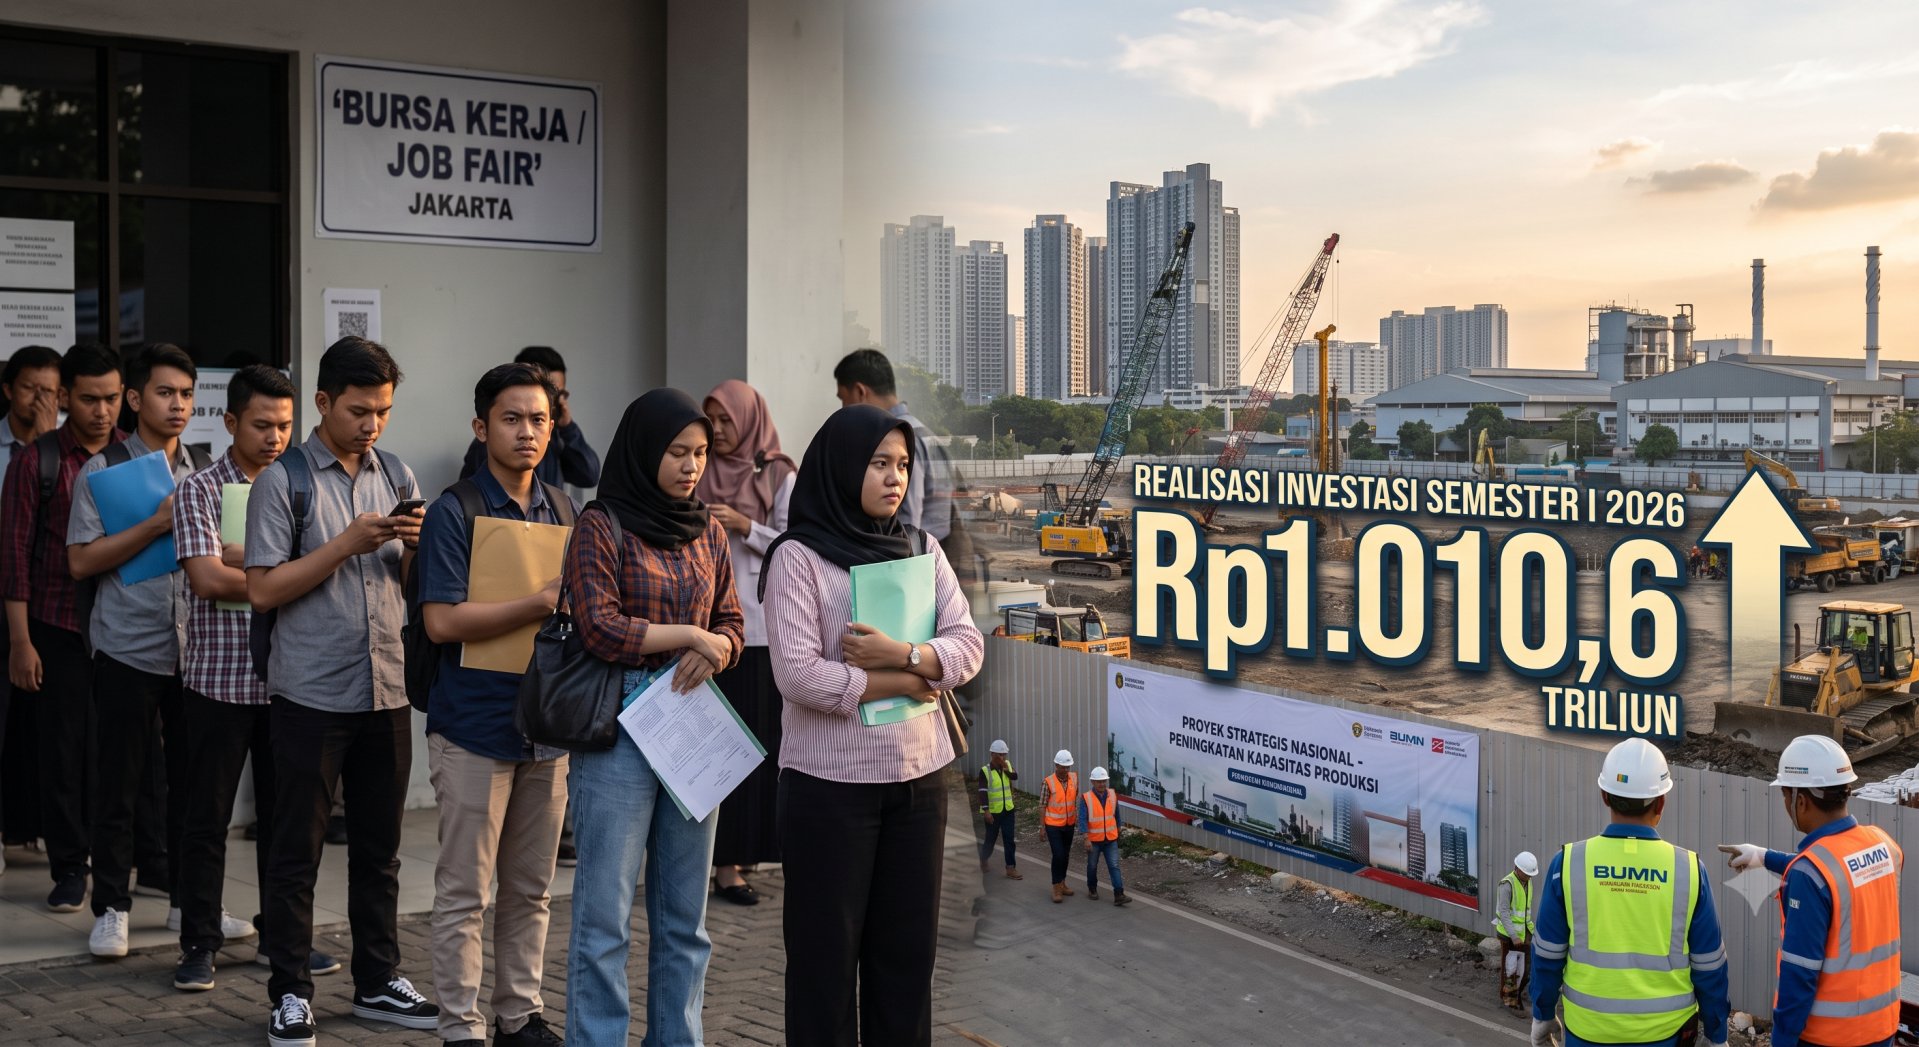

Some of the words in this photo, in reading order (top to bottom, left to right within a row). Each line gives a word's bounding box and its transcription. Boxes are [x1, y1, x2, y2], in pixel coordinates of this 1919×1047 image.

[466, 100, 569, 143] KERJA
[387, 142, 453, 180] JOB
[408, 192, 513, 221] JAKARTA
[1182, 715, 1225, 738] PROYEK
[1227, 726, 1288, 752] STRATEGIS
[1291, 738, 1354, 767] NASIONAL
[1390, 730, 1425, 747] BUMN
[1169, 731, 1244, 762] PENINGKATAN
[1247, 750, 1311, 778] KAPASITAS
[1315, 765, 1379, 794] PRODUKSI
[1593, 865, 1668, 883] BUMN
[1847, 847, 1889, 873] BUMN
